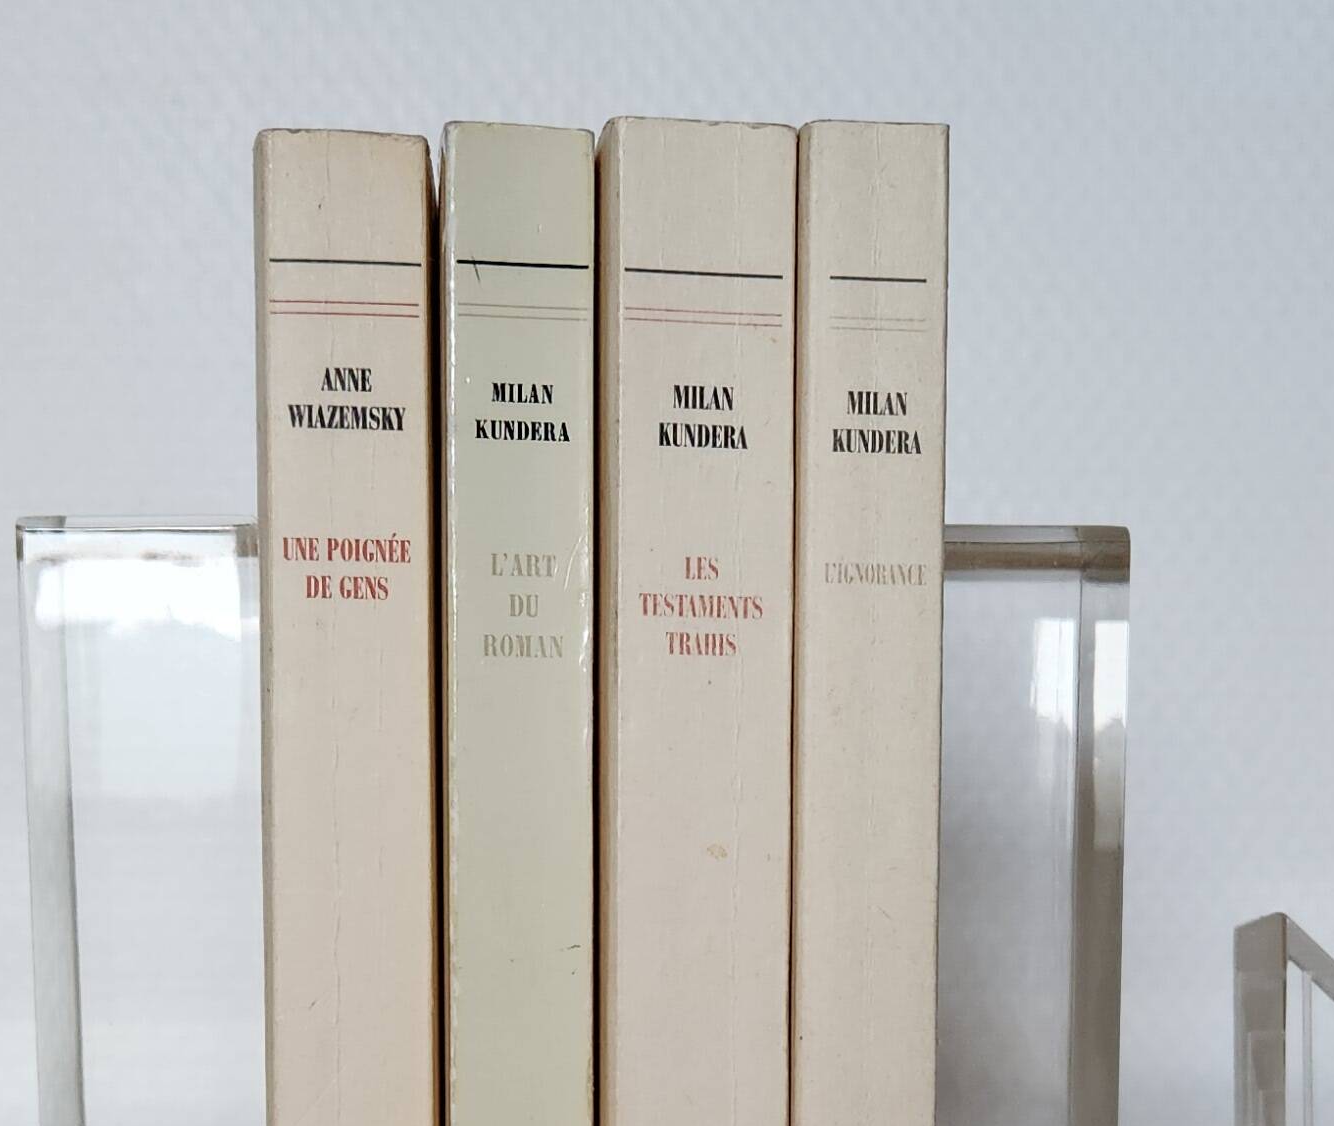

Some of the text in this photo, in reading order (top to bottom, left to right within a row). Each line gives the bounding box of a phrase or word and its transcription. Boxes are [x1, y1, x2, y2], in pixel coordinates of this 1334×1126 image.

[321, 368, 371, 392] ANNE
[492, 383, 553, 404] MILAN
[674, 385, 733, 410] MILAN
[848, 391, 907, 415] MILAN
[289, 405, 405, 431] WIAZEMSKY
[475, 419, 570, 442] KUNDERA
[659, 423, 747, 449] KUNDERA
[833, 429, 921, 454] KUNDERA
[283, 533, 410, 563] UNE POIGNÉE
[491, 553, 556, 577] L'ART
[686, 557, 718, 579] LES
[825, 563, 926, 585] L'IGNORANCE
[307, 576, 388, 600] DE GENS
[509, 594, 538, 617] DU
[639, 593, 762, 619] TESTAMENTS
[484, 634, 563, 657] ROMAN
[666, 632, 736, 656] TRAHIS
